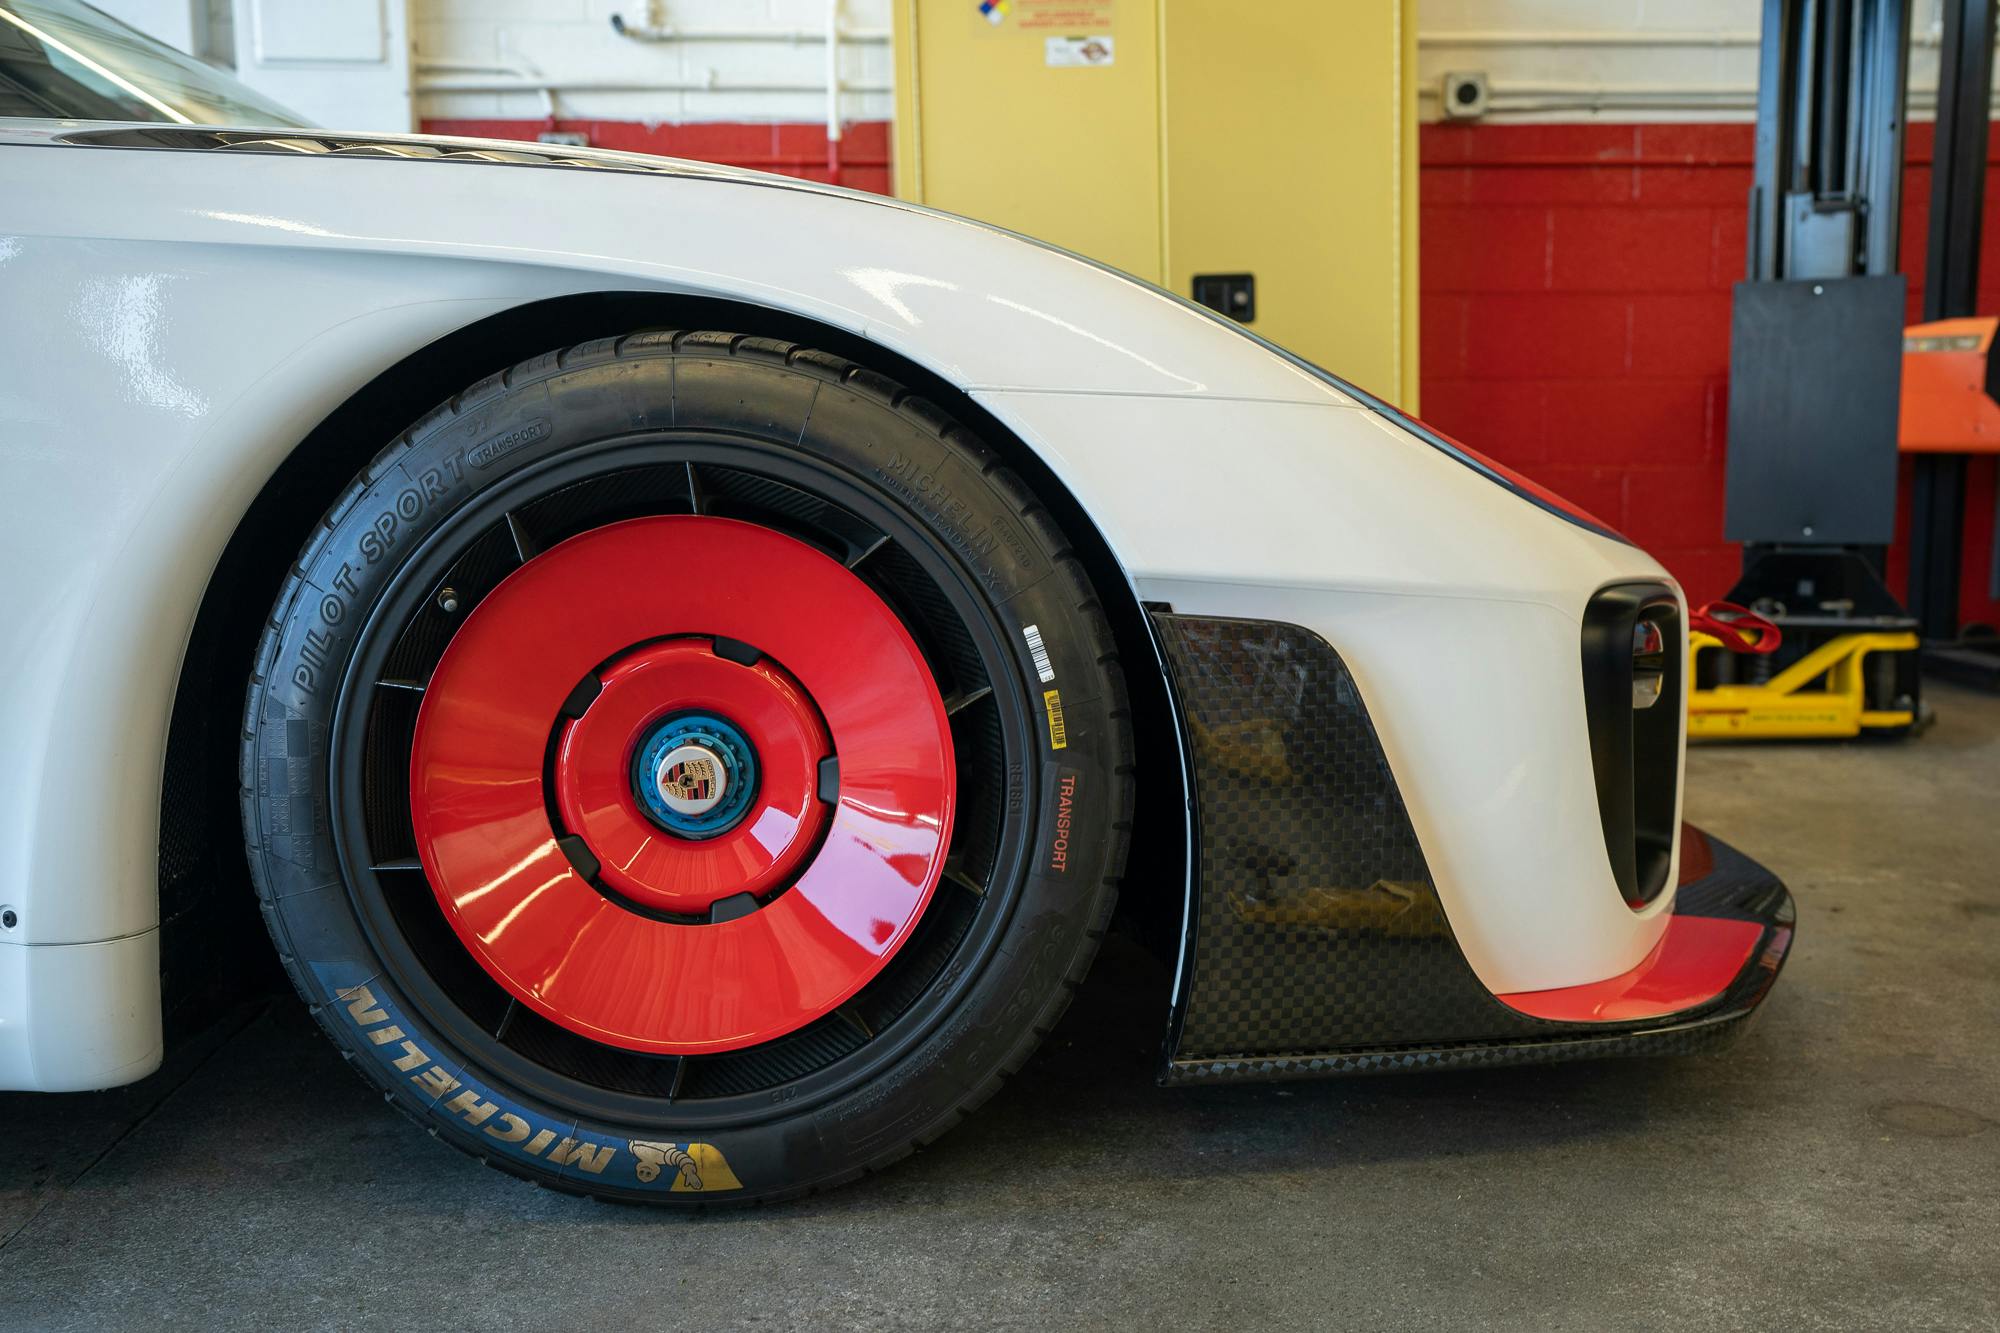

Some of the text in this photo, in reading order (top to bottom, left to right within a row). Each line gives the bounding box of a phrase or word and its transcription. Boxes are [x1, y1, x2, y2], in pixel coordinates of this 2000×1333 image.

[473, 423, 546, 463] TRANSPORT
[887, 453, 1000, 554] MICHELIN
[292, 447, 468, 696] PILOT SPORT
[1051, 775, 1076, 873] TRANSPORT
[334, 985, 617, 1175] MICHELIN
